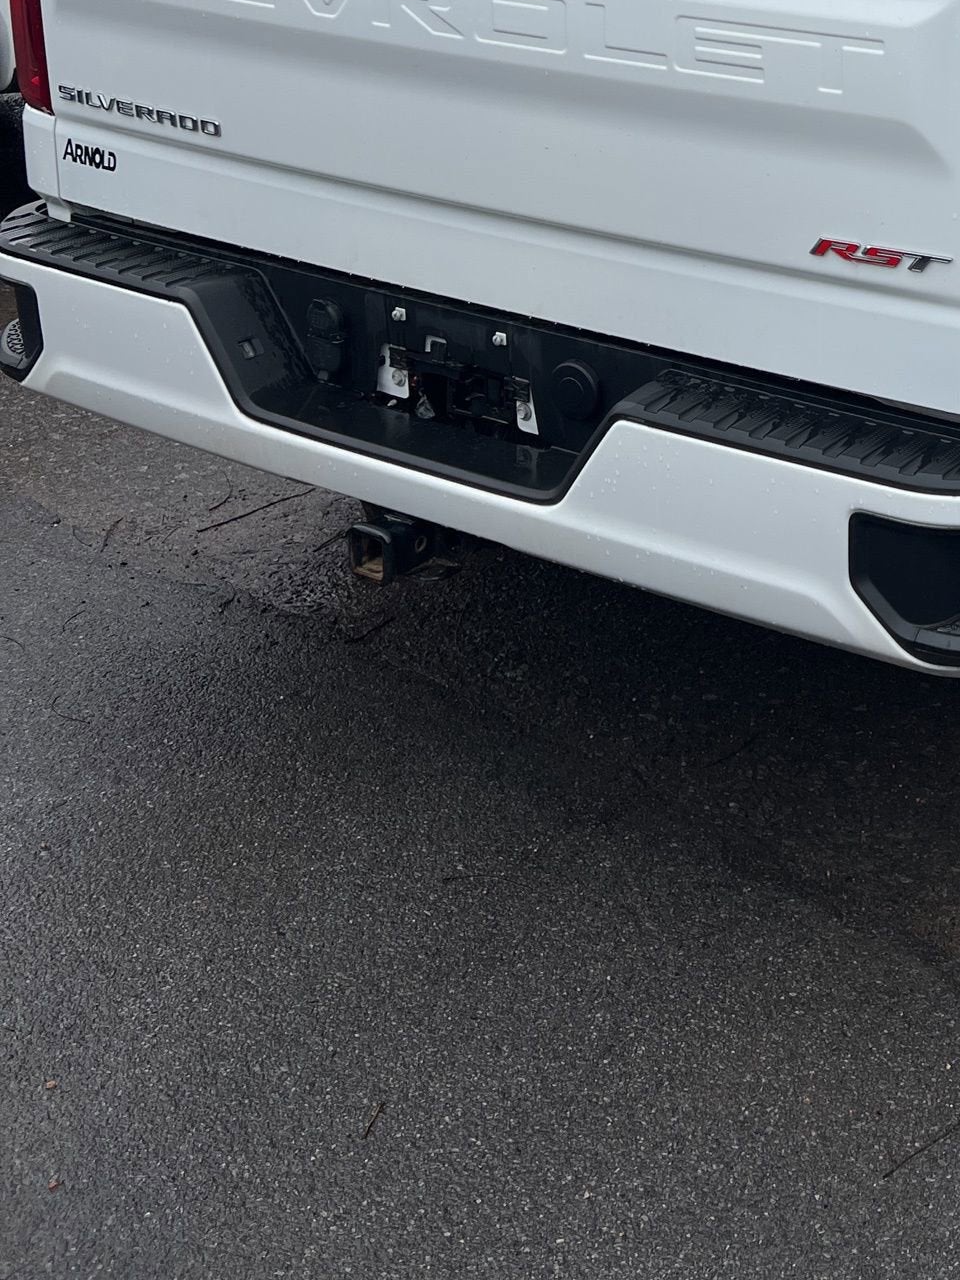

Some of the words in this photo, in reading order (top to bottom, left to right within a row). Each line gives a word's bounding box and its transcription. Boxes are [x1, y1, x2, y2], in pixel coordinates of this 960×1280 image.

[58, 84, 222, 137] SILVERADO
[63, 138, 117, 172] ARNOLD
[809, 237, 954, 273] RST
